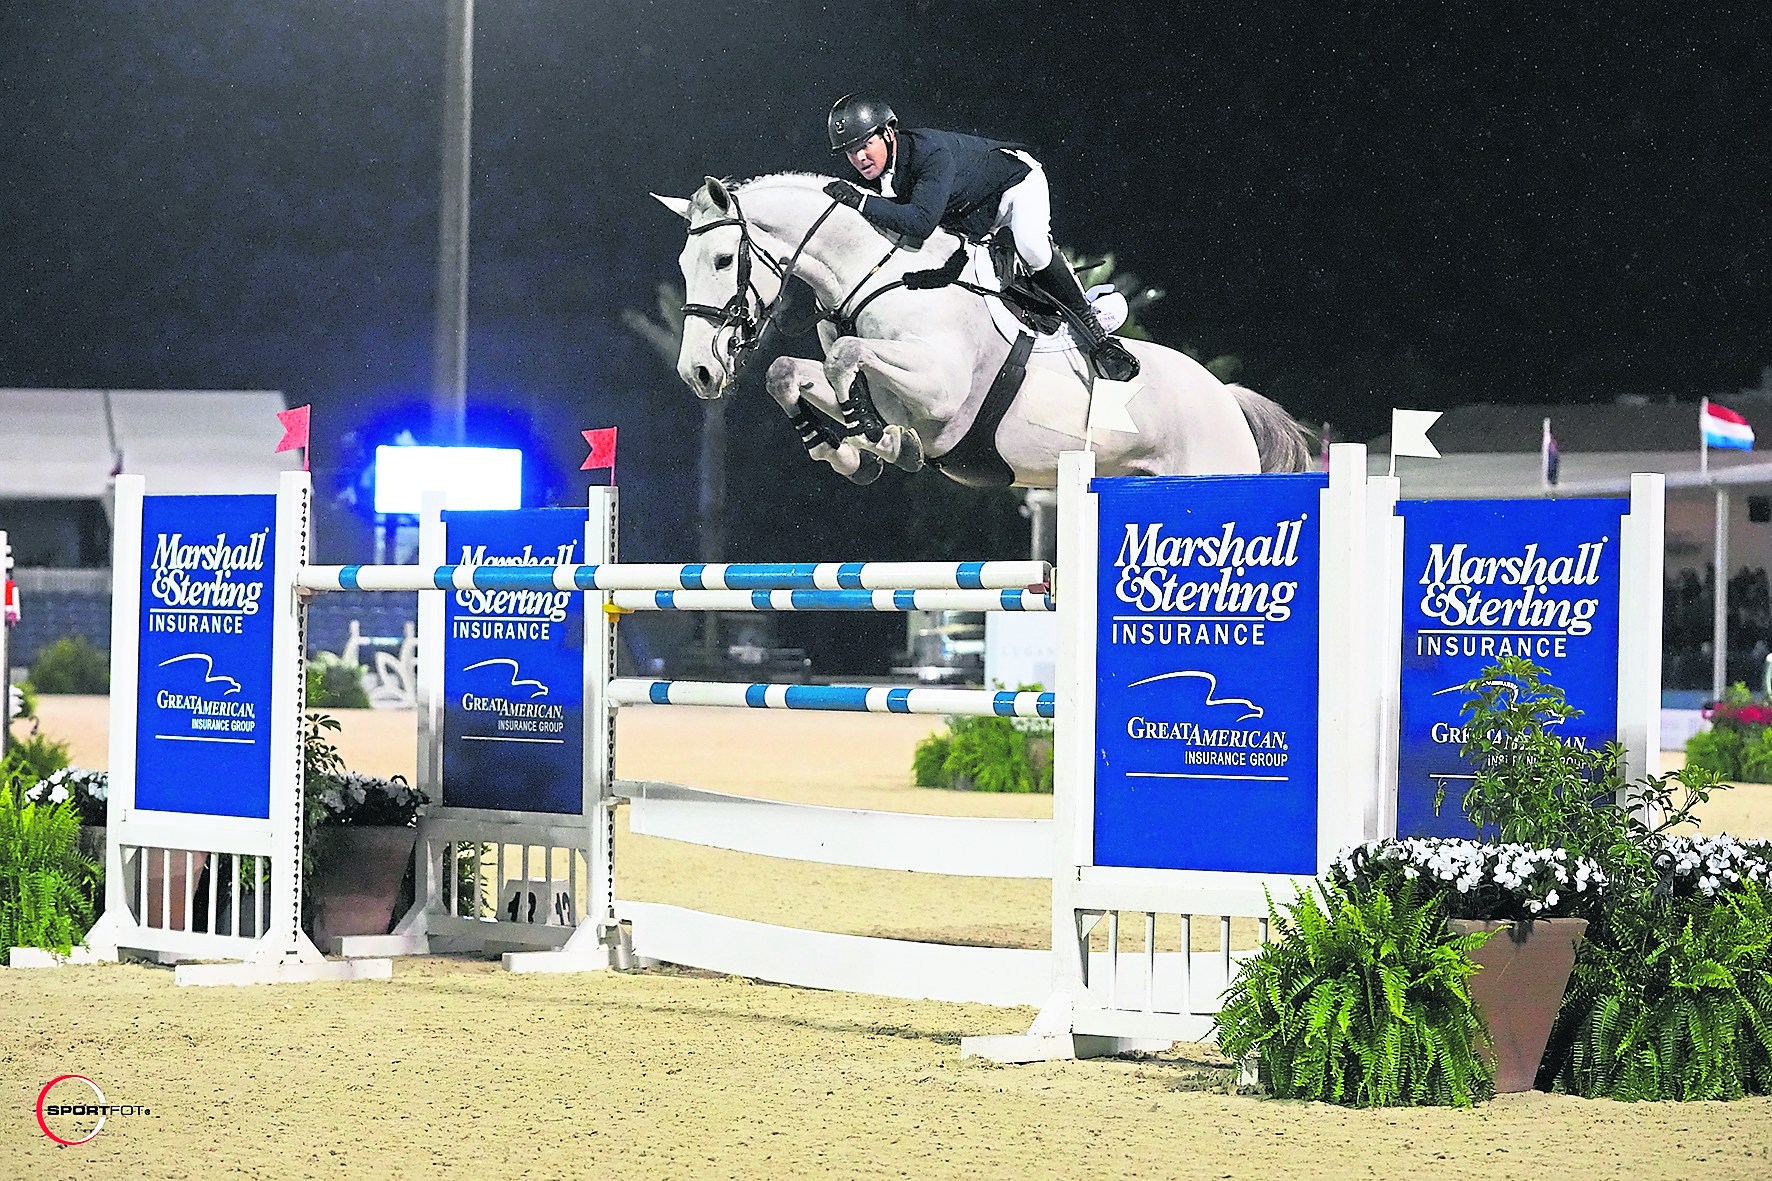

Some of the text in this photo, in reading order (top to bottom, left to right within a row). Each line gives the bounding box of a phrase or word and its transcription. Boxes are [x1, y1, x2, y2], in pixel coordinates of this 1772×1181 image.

[151, 532, 266, 570] Marshall
[1113, 520, 1303, 567] Marshall
[1419, 542, 1604, 585] Marshall
[149, 614, 243, 634] INSURANCE
[453, 621, 550, 640] INSURANCE
[1111, 623, 1265, 646] INSURANCE
[1416, 636, 1567, 658] INSURANCE
[191, 718, 255, 732] INSURANCE GROUP
[498, 719, 564, 733] INSURANCE GROUP
[1185, 750, 1288, 767] INSURANCE GROUP
